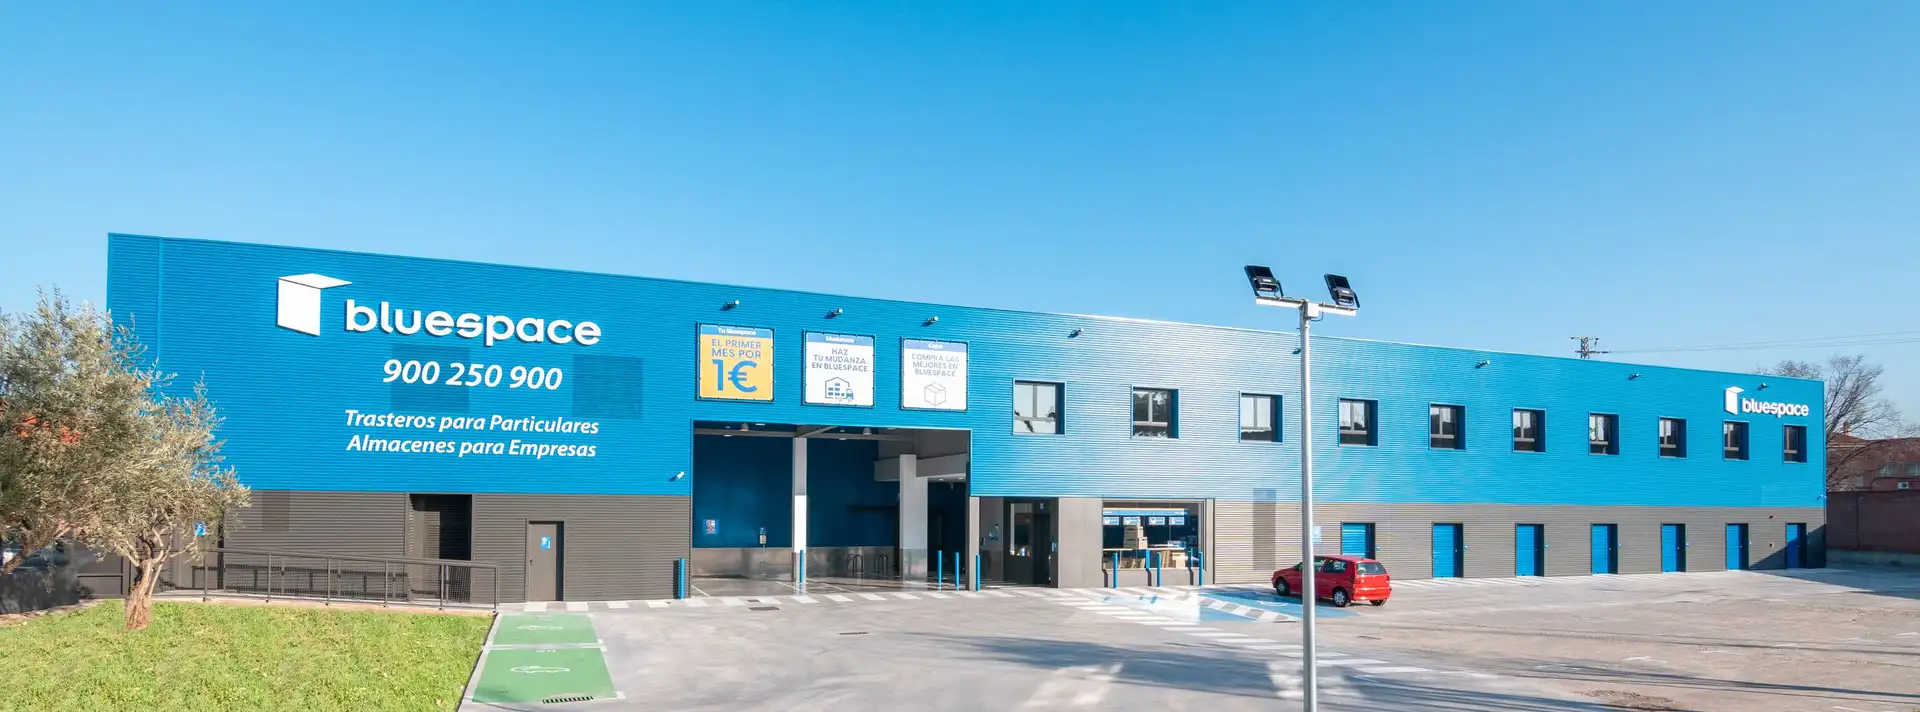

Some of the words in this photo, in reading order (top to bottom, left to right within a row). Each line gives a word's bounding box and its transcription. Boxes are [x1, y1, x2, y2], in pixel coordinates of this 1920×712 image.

[345, 298, 602, 347] bluespace
[711, 338, 722, 347] EL
[725, 339, 762, 349] PRIMER
[711, 348, 735, 357] MES
[738, 349, 762, 359] POR
[831, 348, 849, 356] HAZ
[825, 355, 867, 365] MUDANZA
[911, 353, 944, 362] COMPRA
[945, 355, 960, 363] LAS
[823, 362, 869, 372] BLUESPACE
[912, 361, 947, 369] MEJORES
[948, 362, 959, 370] EN
[382, 358, 441, 386] 900
[445, 362, 503, 388] 250
[508, 365, 563, 390] 900
[711, 358, 758, 393] 1€
[914, 368, 956, 377] BLUESPACE
[1742, 397, 1810, 419] bluespace
[344, 409, 436, 430] Trasteros
[438, 417, 486, 433] para
[489, 415, 600, 434] Particulares
[346, 434, 456, 454] Almacenes
[458, 442, 505, 458] para
[508, 440, 597, 460] Empresas
